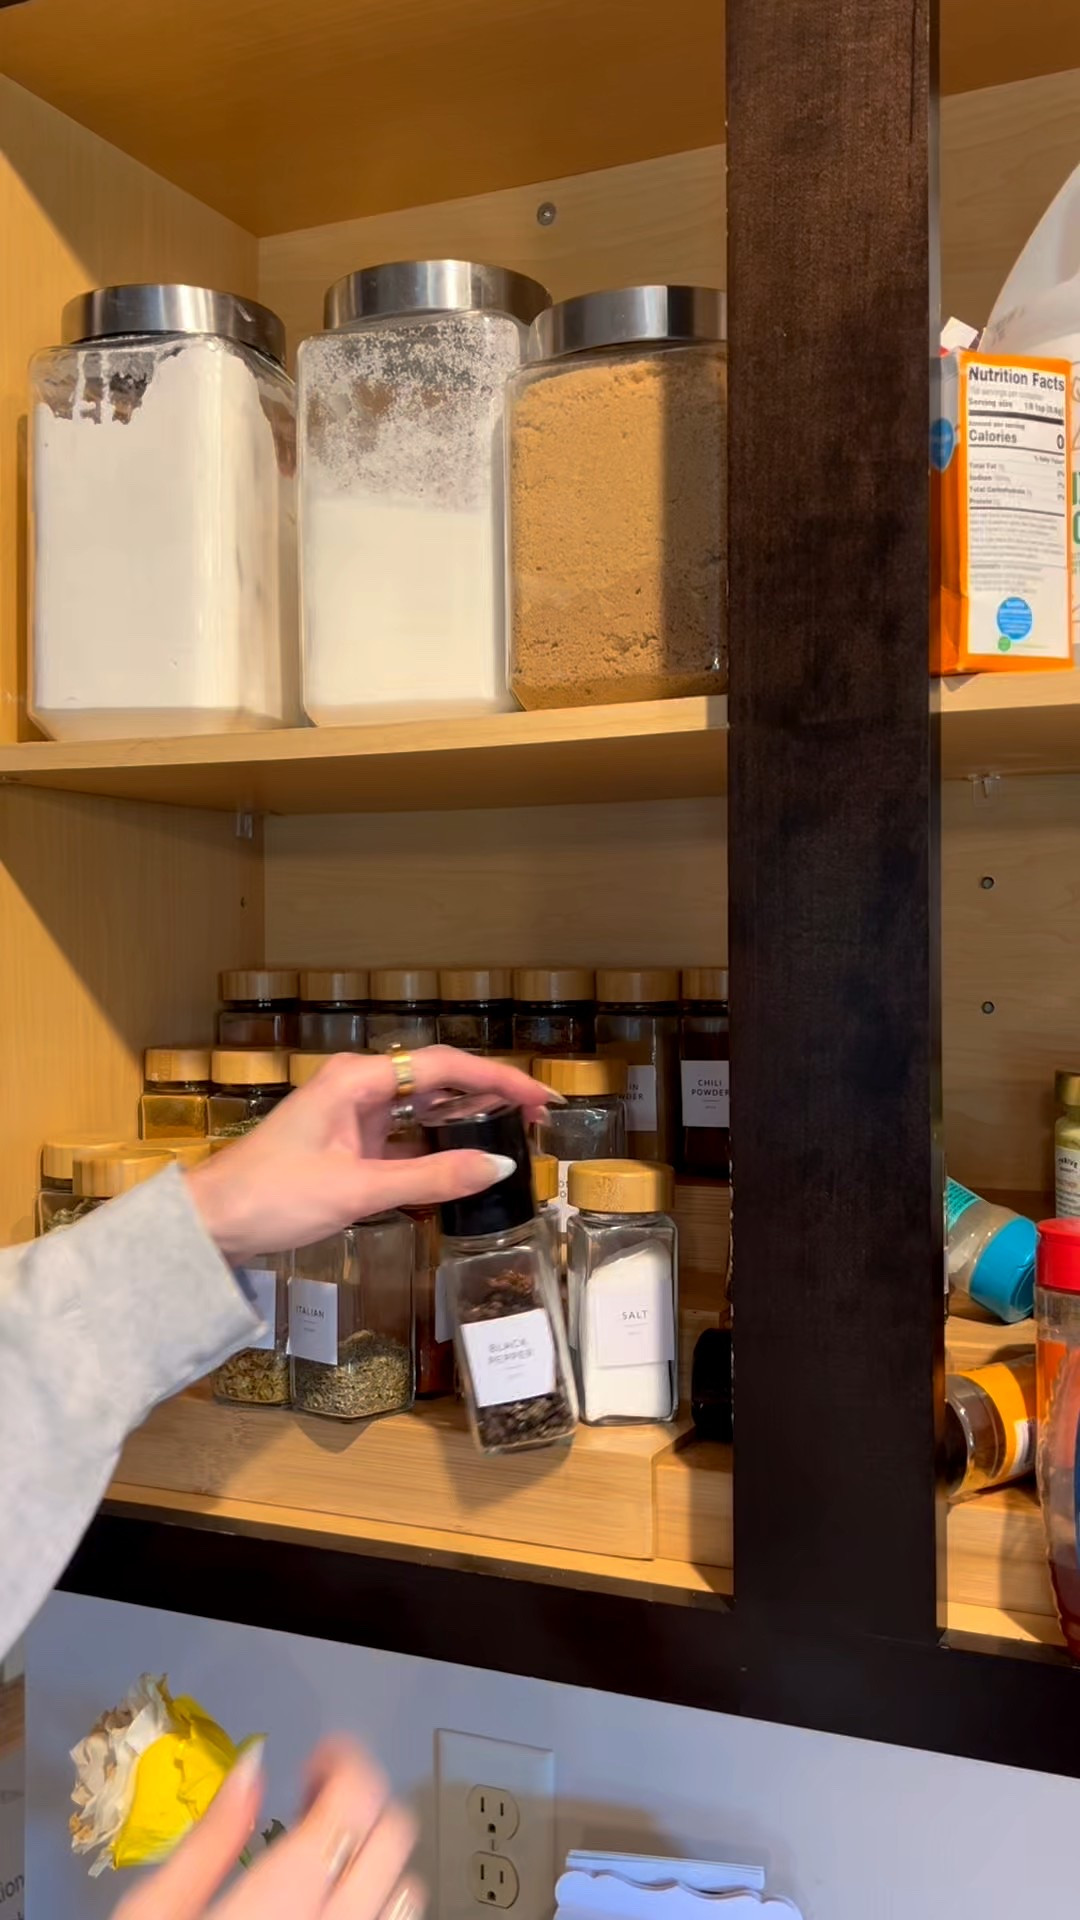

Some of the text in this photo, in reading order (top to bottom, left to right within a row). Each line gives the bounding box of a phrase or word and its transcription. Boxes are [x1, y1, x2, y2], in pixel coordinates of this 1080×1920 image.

[969, 367, 1065, 392] Nutrition Facts
[969, 398, 996, 407] Serving
[969, 429, 1065, 450] Calories 0
[697, 1079, 723, 1087] CHILI
[296, 1305, 325, 1319] ITALIAN
[622, 1309, 649, 1321] SALT
[488, 1338, 528, 1353] BLACK
[488, 1349, 533, 1365] PEPPER
